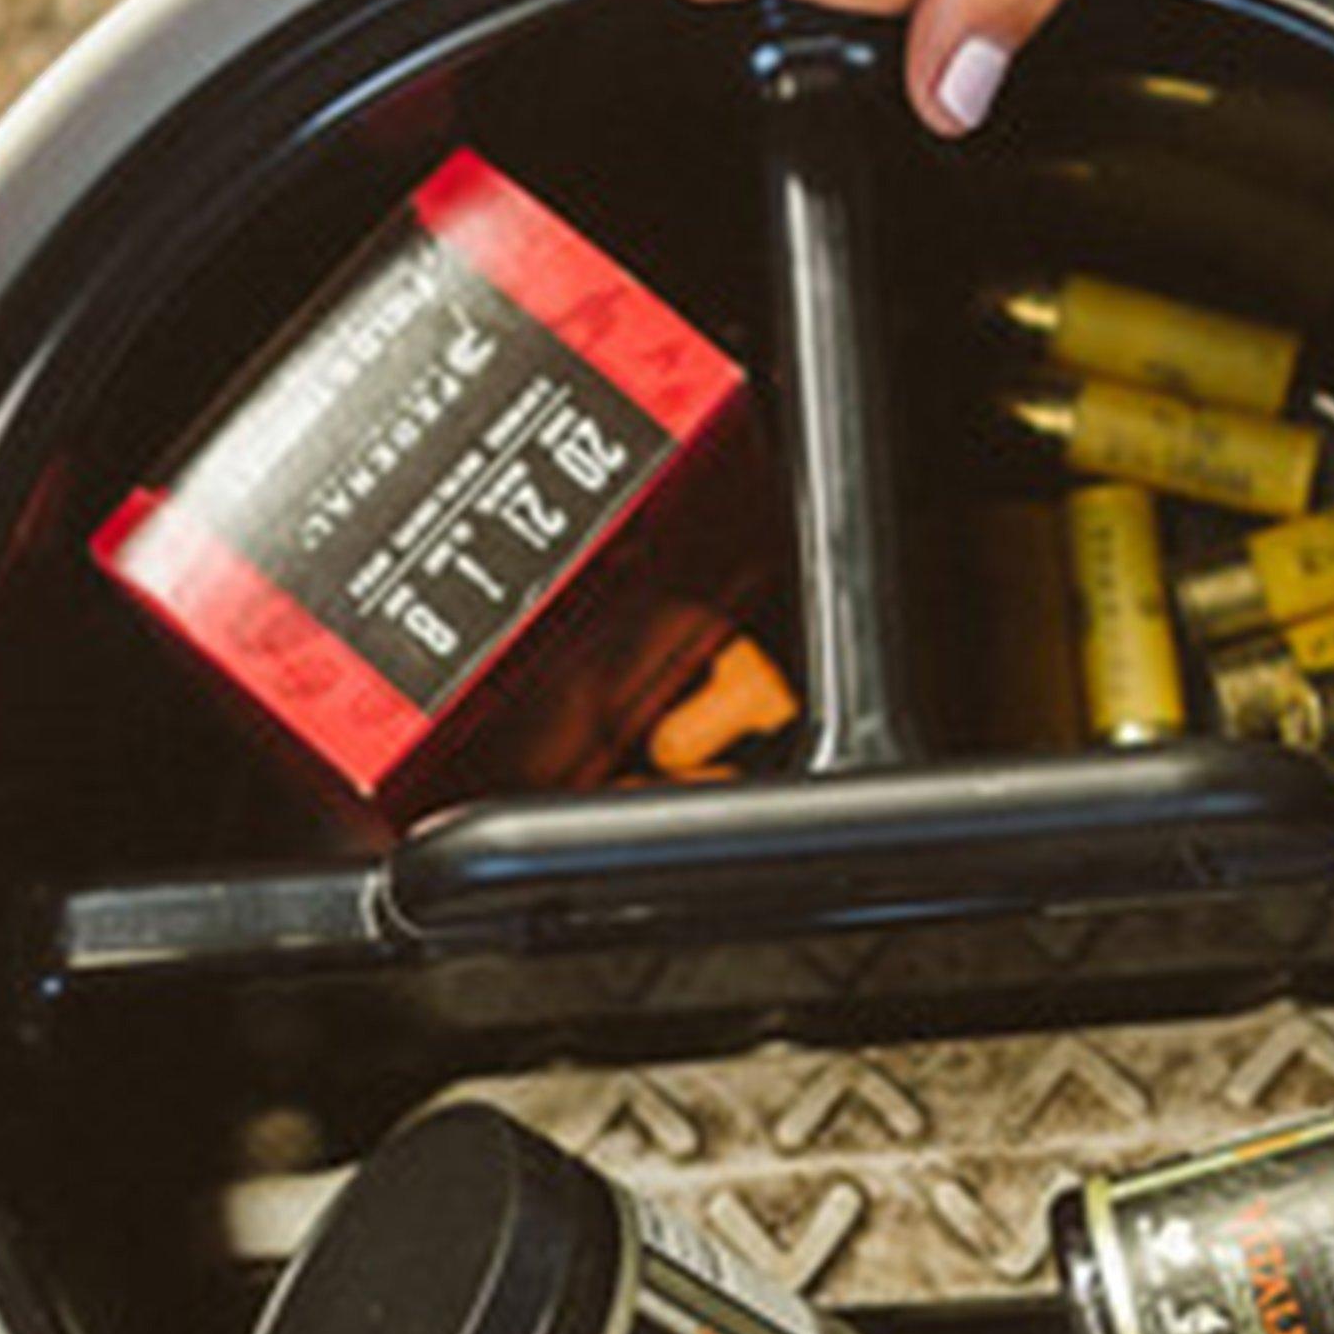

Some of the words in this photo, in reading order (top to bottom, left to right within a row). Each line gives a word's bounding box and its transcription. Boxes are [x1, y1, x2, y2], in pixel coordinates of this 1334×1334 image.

[298, 368, 465, 547] FEDERAL
[546, 413, 632, 497] 20
[400, 598, 461, 658] 8
